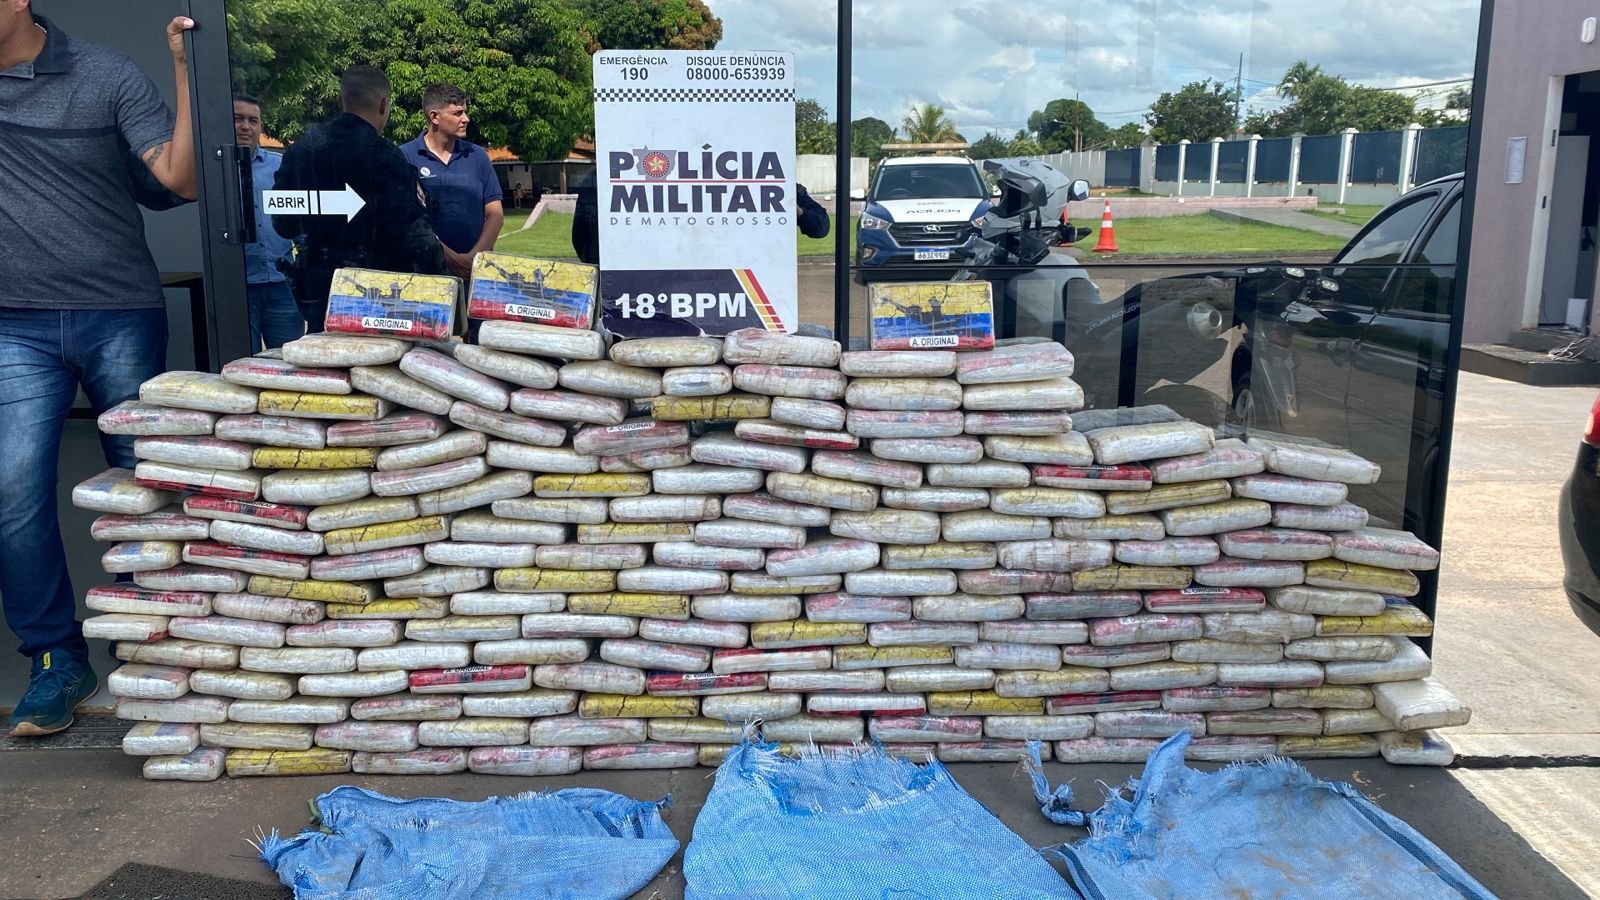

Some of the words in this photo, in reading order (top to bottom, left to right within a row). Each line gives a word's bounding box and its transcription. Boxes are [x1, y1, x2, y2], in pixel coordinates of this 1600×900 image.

[600, 55, 668, 65] EMERGÊNCIA
[686, 56, 727, 66] DISQUE
[730, 54, 786, 66] DENÚNCIA
[620, 67, 649, 81] 190
[686, 67, 786, 81] 08000-653939
[268, 196, 306, 209] ABRIR
[610, 185, 786, 213] MILITAR
[610, 217, 631, 226] DE
[641, 217, 697, 226] MATO
[706, 217, 788, 226] GROSSO
[508, 305, 516, 314] A.
[517, 306, 553, 319] ORIGINAL
[364, 319, 372, 327] A.
[373, 319, 410, 330] ORIGINAL
[912, 338, 919, 346] A.
[921, 337, 956, 346] ORIGINAL
